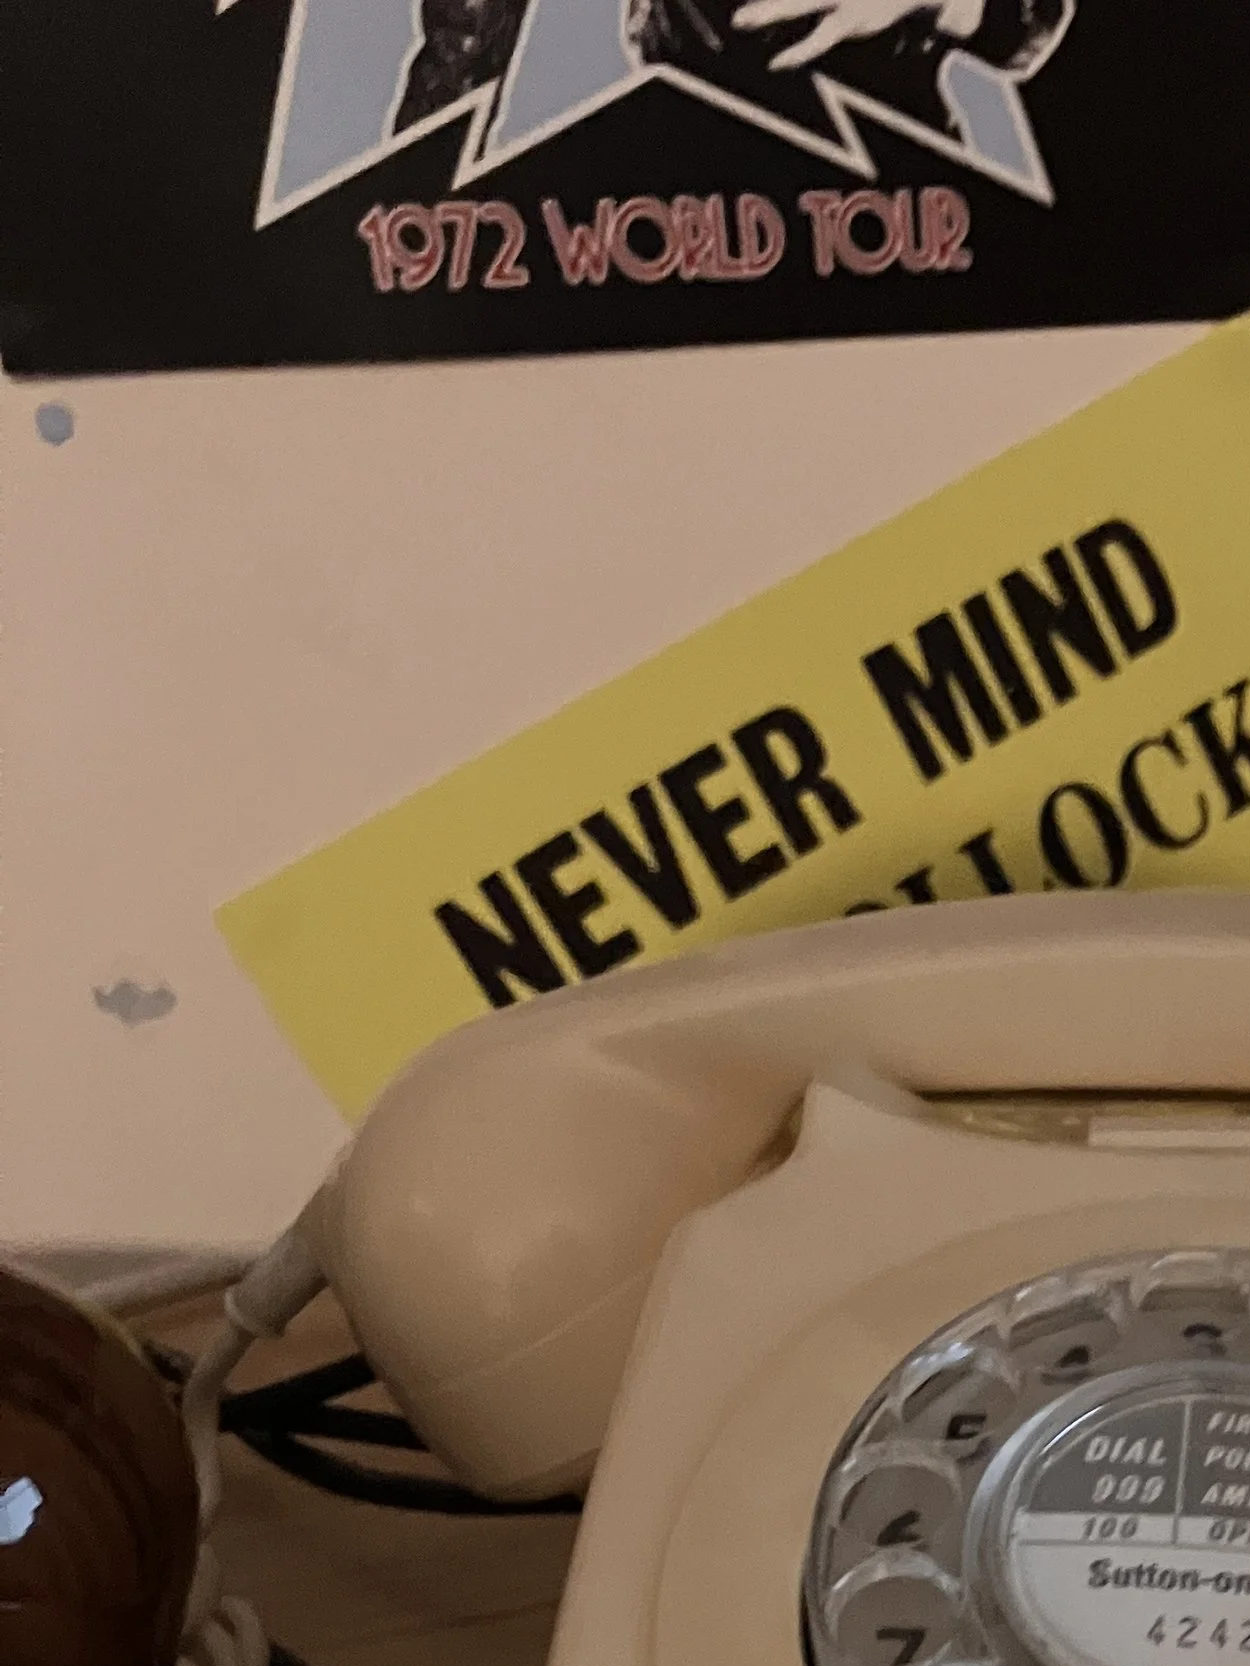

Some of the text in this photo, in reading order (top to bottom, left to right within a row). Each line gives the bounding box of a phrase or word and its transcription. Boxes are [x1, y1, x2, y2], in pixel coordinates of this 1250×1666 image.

[357, 186, 975, 292] 1972 WORLD TOUR
[432, 516, 1178, 1010] NEVER MIND
[1084, 1435, 1167, 1466] DIAL
[1092, 1473, 1166, 1504] 999
[1081, 1515, 1139, 1541] 100
